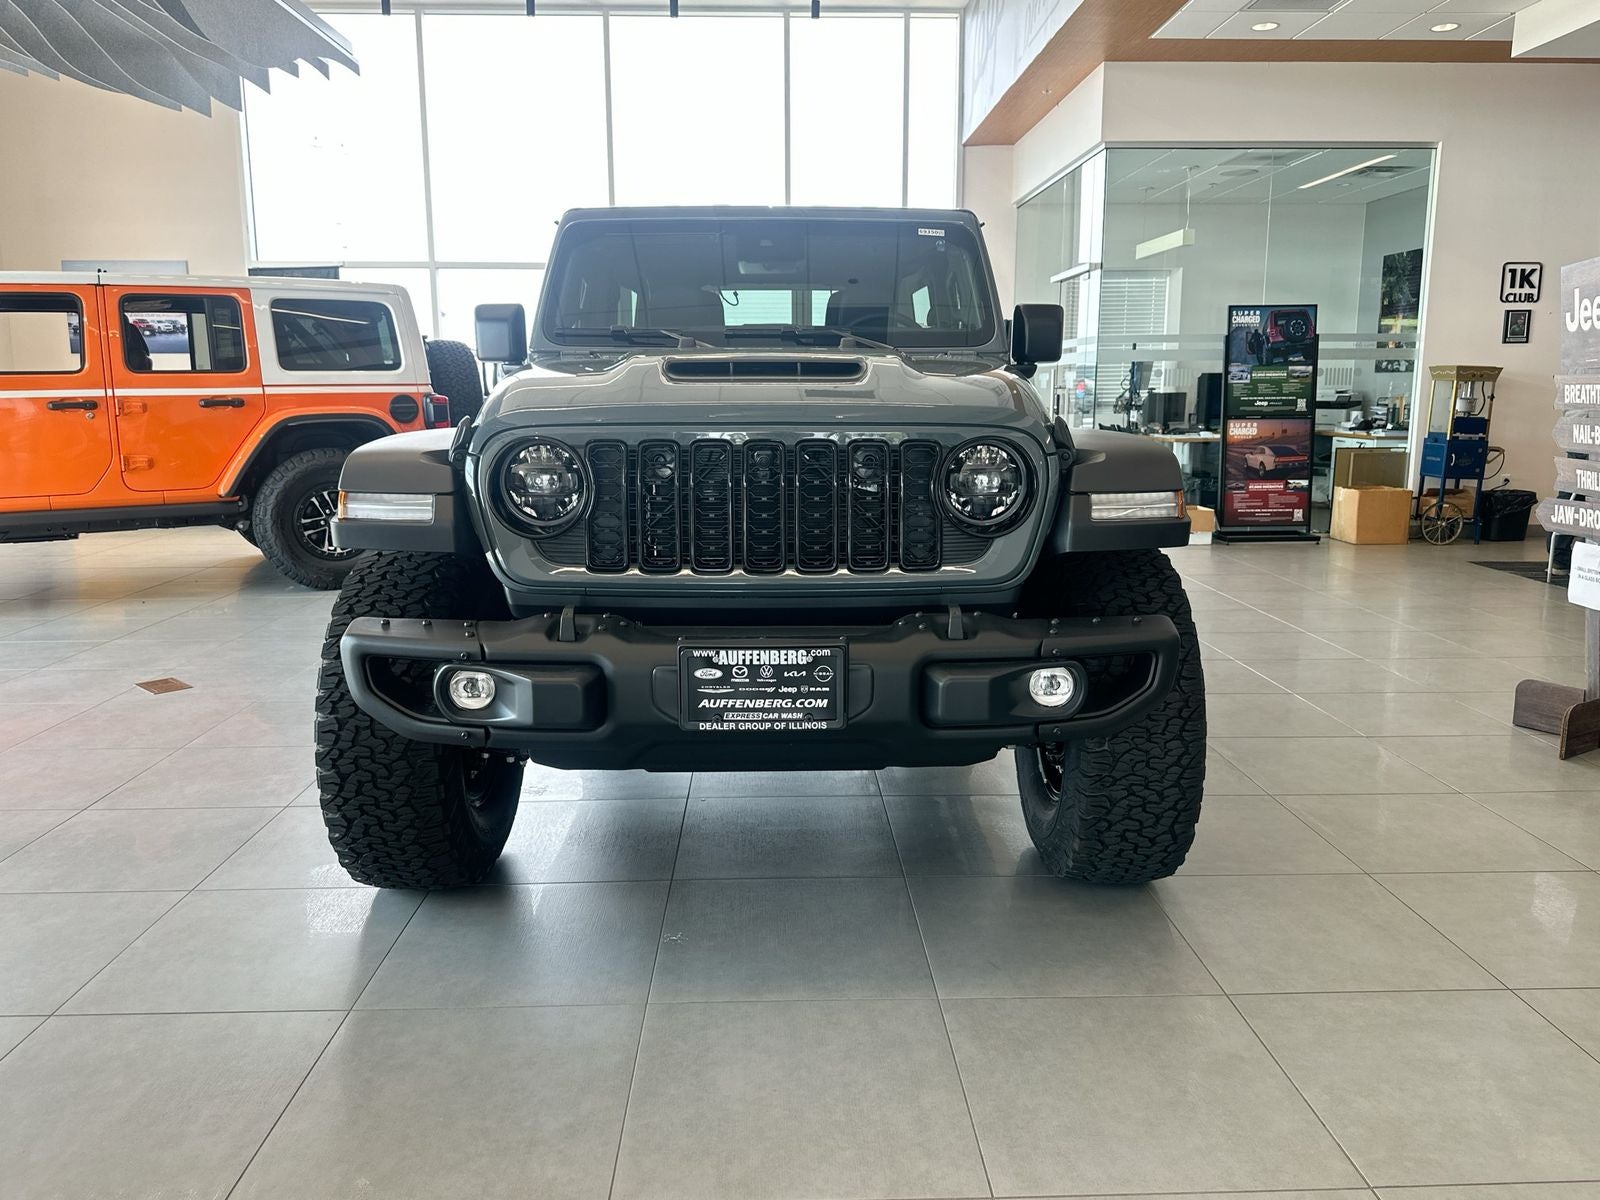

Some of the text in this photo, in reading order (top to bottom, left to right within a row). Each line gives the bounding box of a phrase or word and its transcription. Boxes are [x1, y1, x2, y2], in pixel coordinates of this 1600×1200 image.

[1508, 268, 1538, 289] 1K
[1505, 292, 1535, 303] CLUB
[1232, 315, 1261, 324] CHARGED
[1229, 427, 1258, 436] CHARGED
[1575, 468, 1600, 491] THRIL
[778, 686, 798, 694] Jeep
[698, 699, 829, 709] AUFFENBERG.COM
[724, 712, 762, 720] EXPRESS
[699, 721, 828, 730] DEALER GROUP OF ILLINOIS
